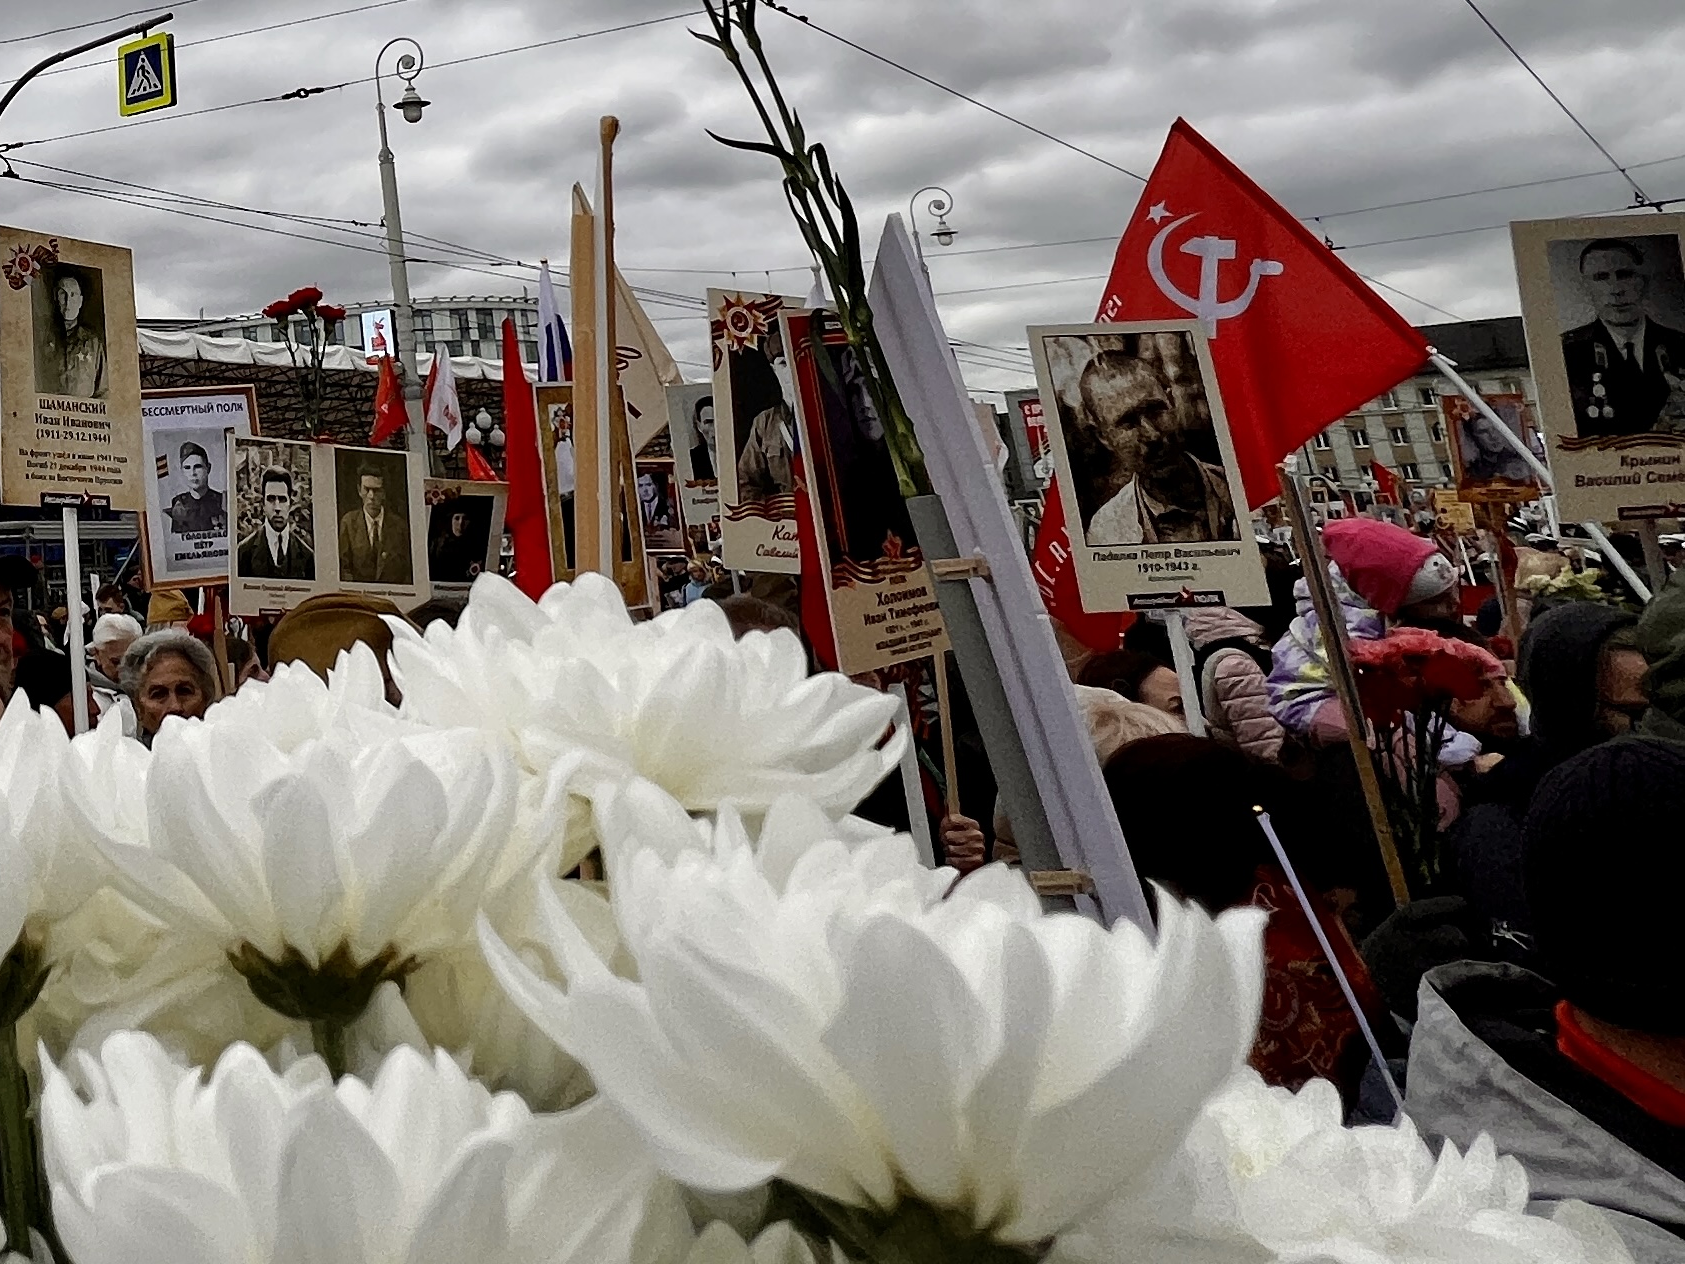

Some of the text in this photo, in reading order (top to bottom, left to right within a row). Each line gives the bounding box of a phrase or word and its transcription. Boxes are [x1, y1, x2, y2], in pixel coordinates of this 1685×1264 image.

[39, 398, 107, 415] ШАМАНСКИЙ
[141, 402, 244, 417] БЕССМЕРТНЫЙ ПОЛК
[34, 413, 112, 430] Иван Иванович
[1575, 471, 1642, 488] Василий
